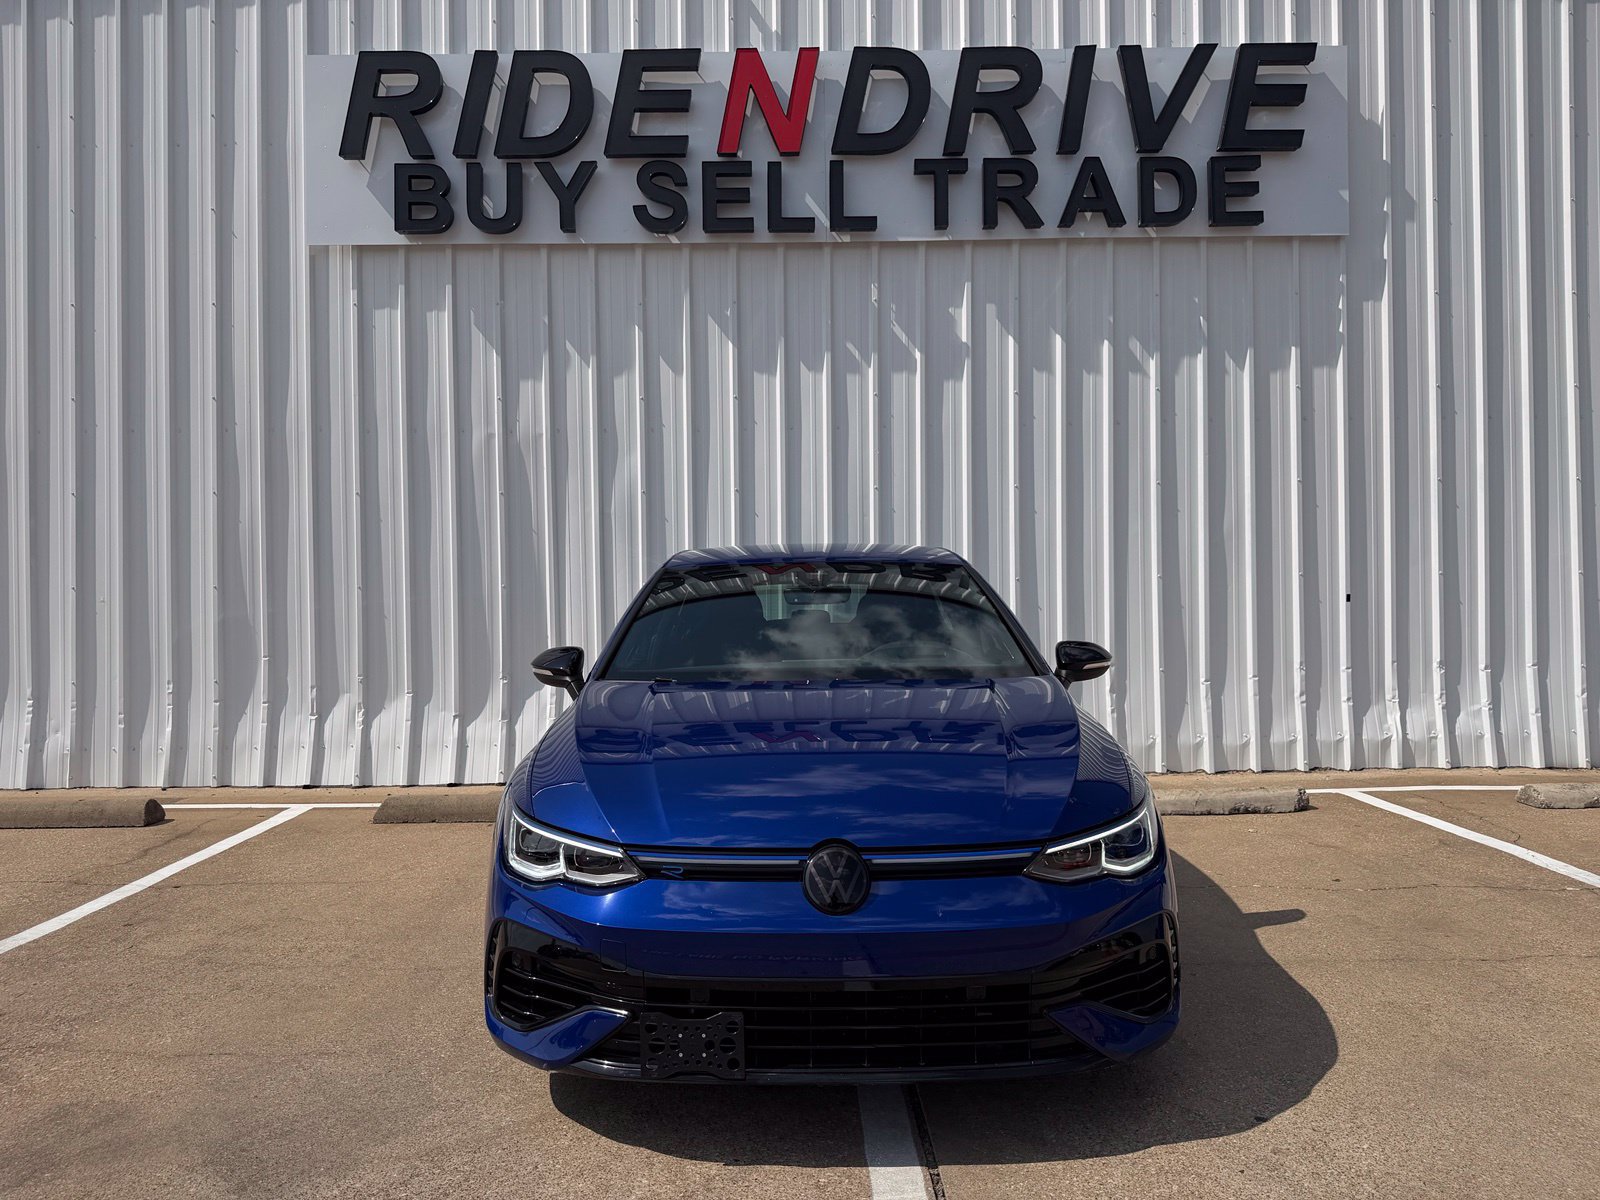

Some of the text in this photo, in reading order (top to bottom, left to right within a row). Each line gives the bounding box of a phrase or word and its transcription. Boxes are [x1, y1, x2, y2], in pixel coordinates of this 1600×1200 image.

[339, 42, 1317, 160] RIDENDRIVE
[394, 155, 1264, 234] BUY SELL TRADE
[806, 846, 869, 908] VW
